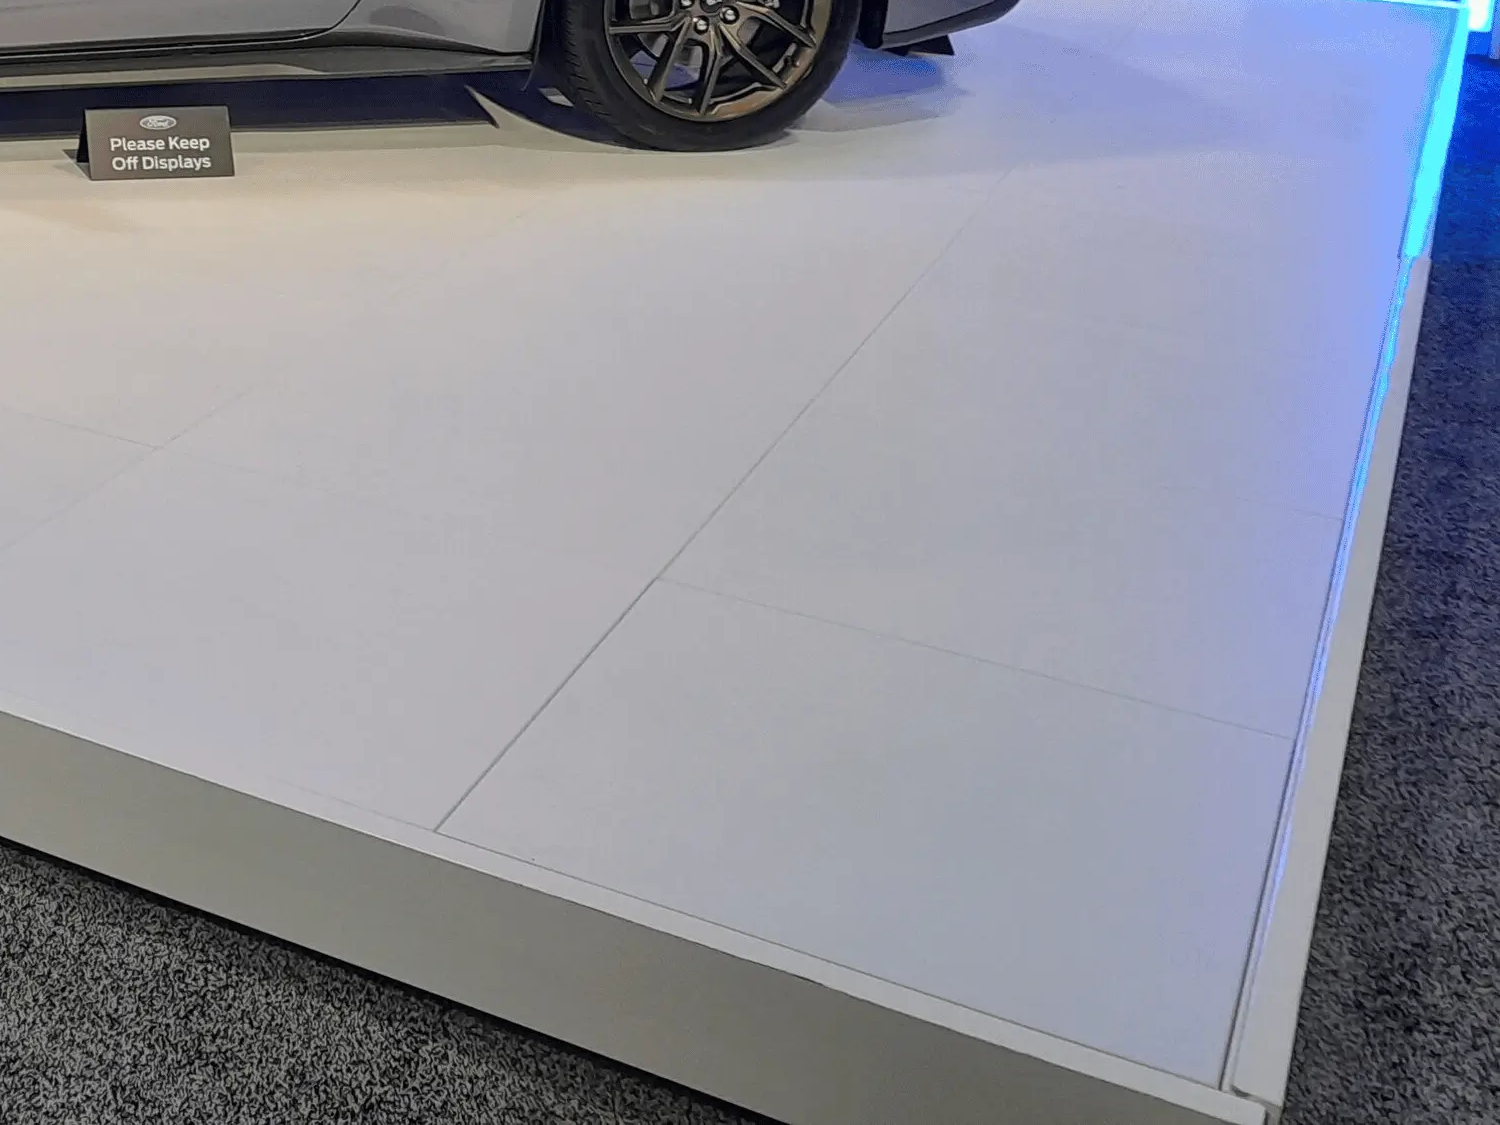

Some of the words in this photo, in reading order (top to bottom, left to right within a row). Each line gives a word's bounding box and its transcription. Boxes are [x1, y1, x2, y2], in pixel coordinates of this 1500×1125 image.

[109, 137, 165, 151] Please
[168, 136, 210, 151] Keep
[112, 156, 139, 171] Off
[142, 155, 212, 172] Displays
